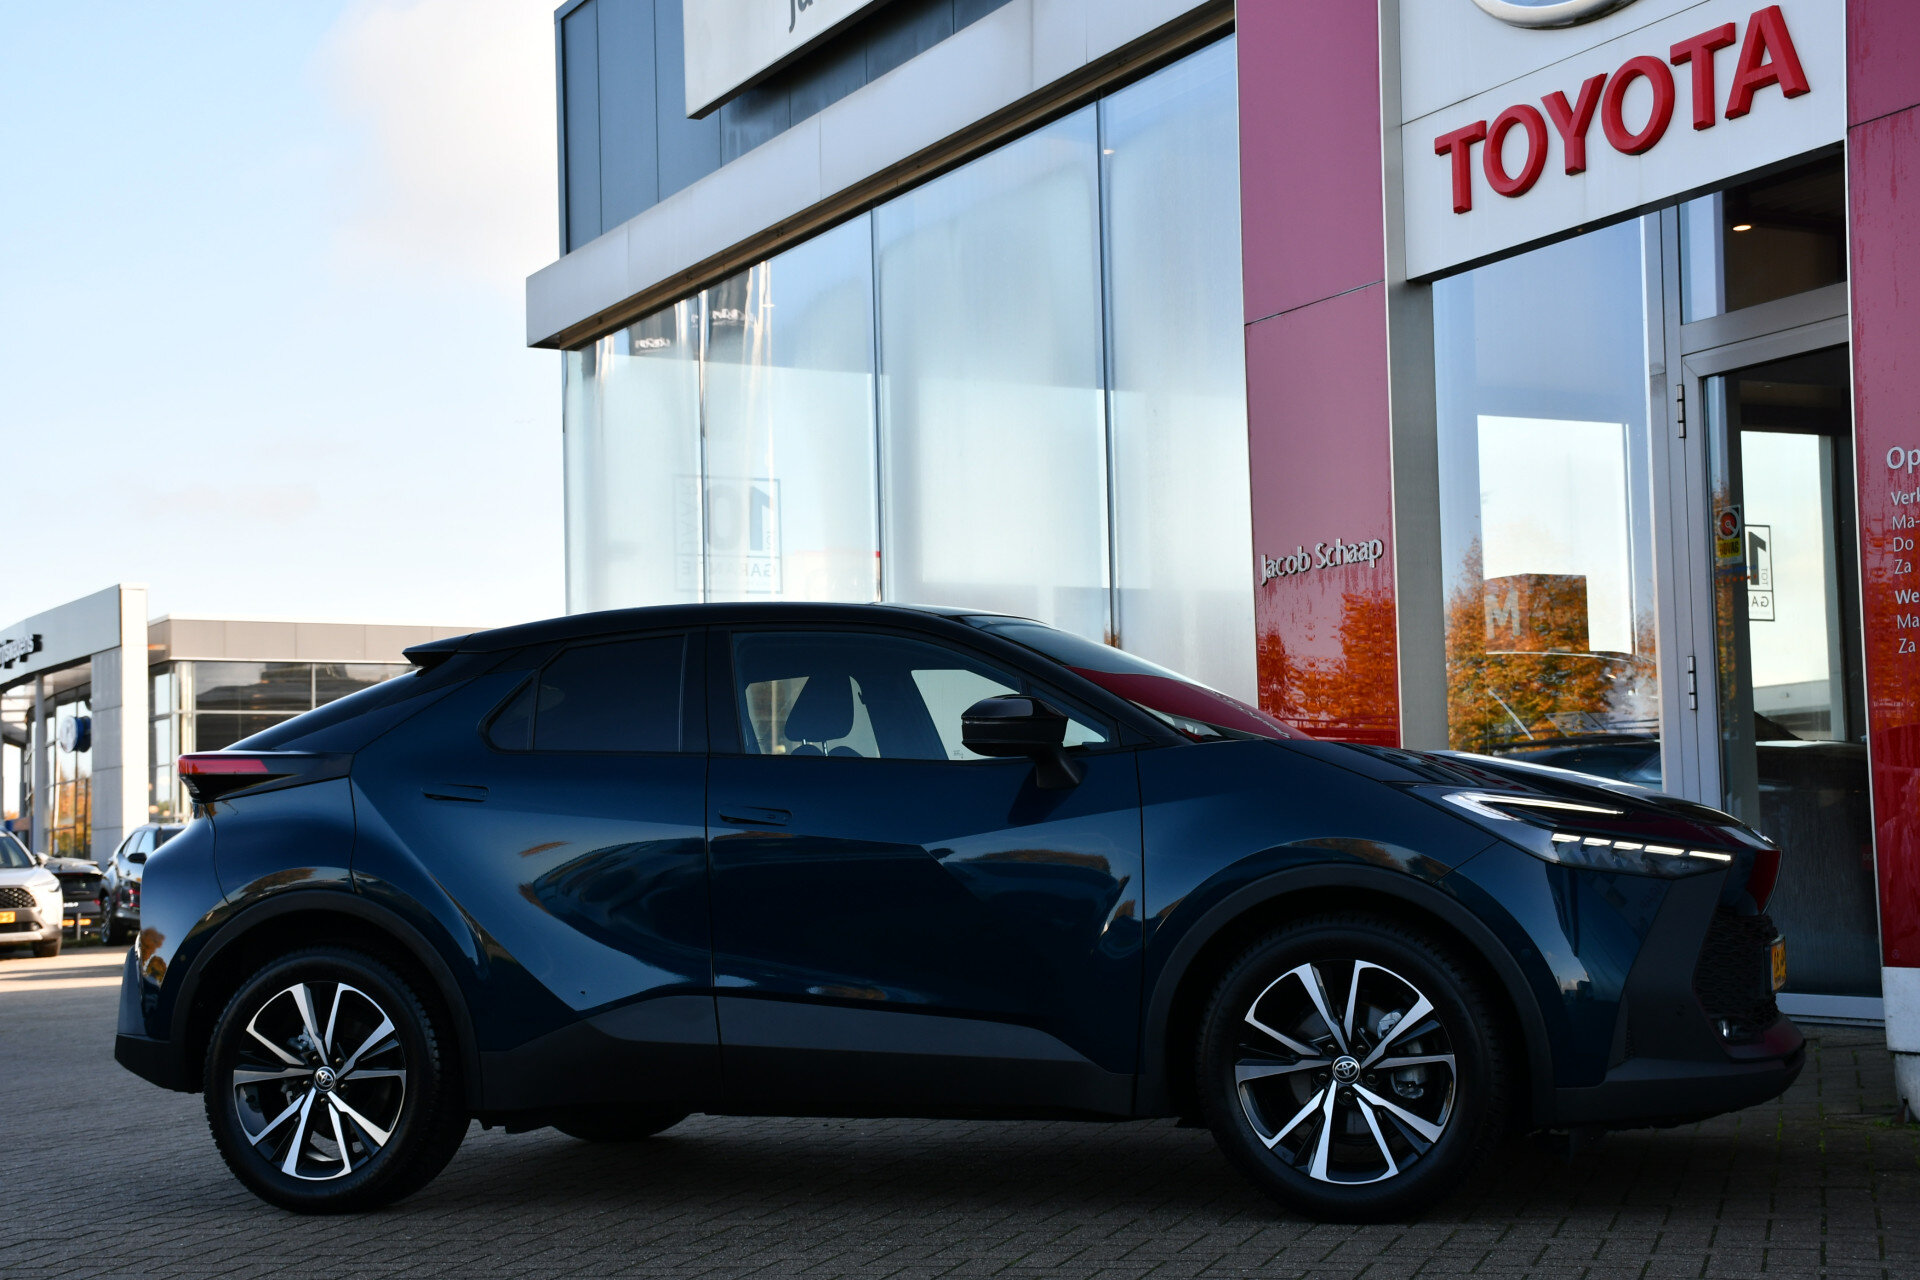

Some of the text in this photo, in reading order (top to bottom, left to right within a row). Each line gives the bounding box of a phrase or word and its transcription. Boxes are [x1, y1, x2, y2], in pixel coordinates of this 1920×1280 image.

[1435, 4, 1811, 215] TOYOTA
[1893, 536, 1914, 552] Do
[1260, 538, 1384, 586] Jacob Schaap
[1894, 559, 1912, 575] Za
[1899, 637, 1916, 654] Za
